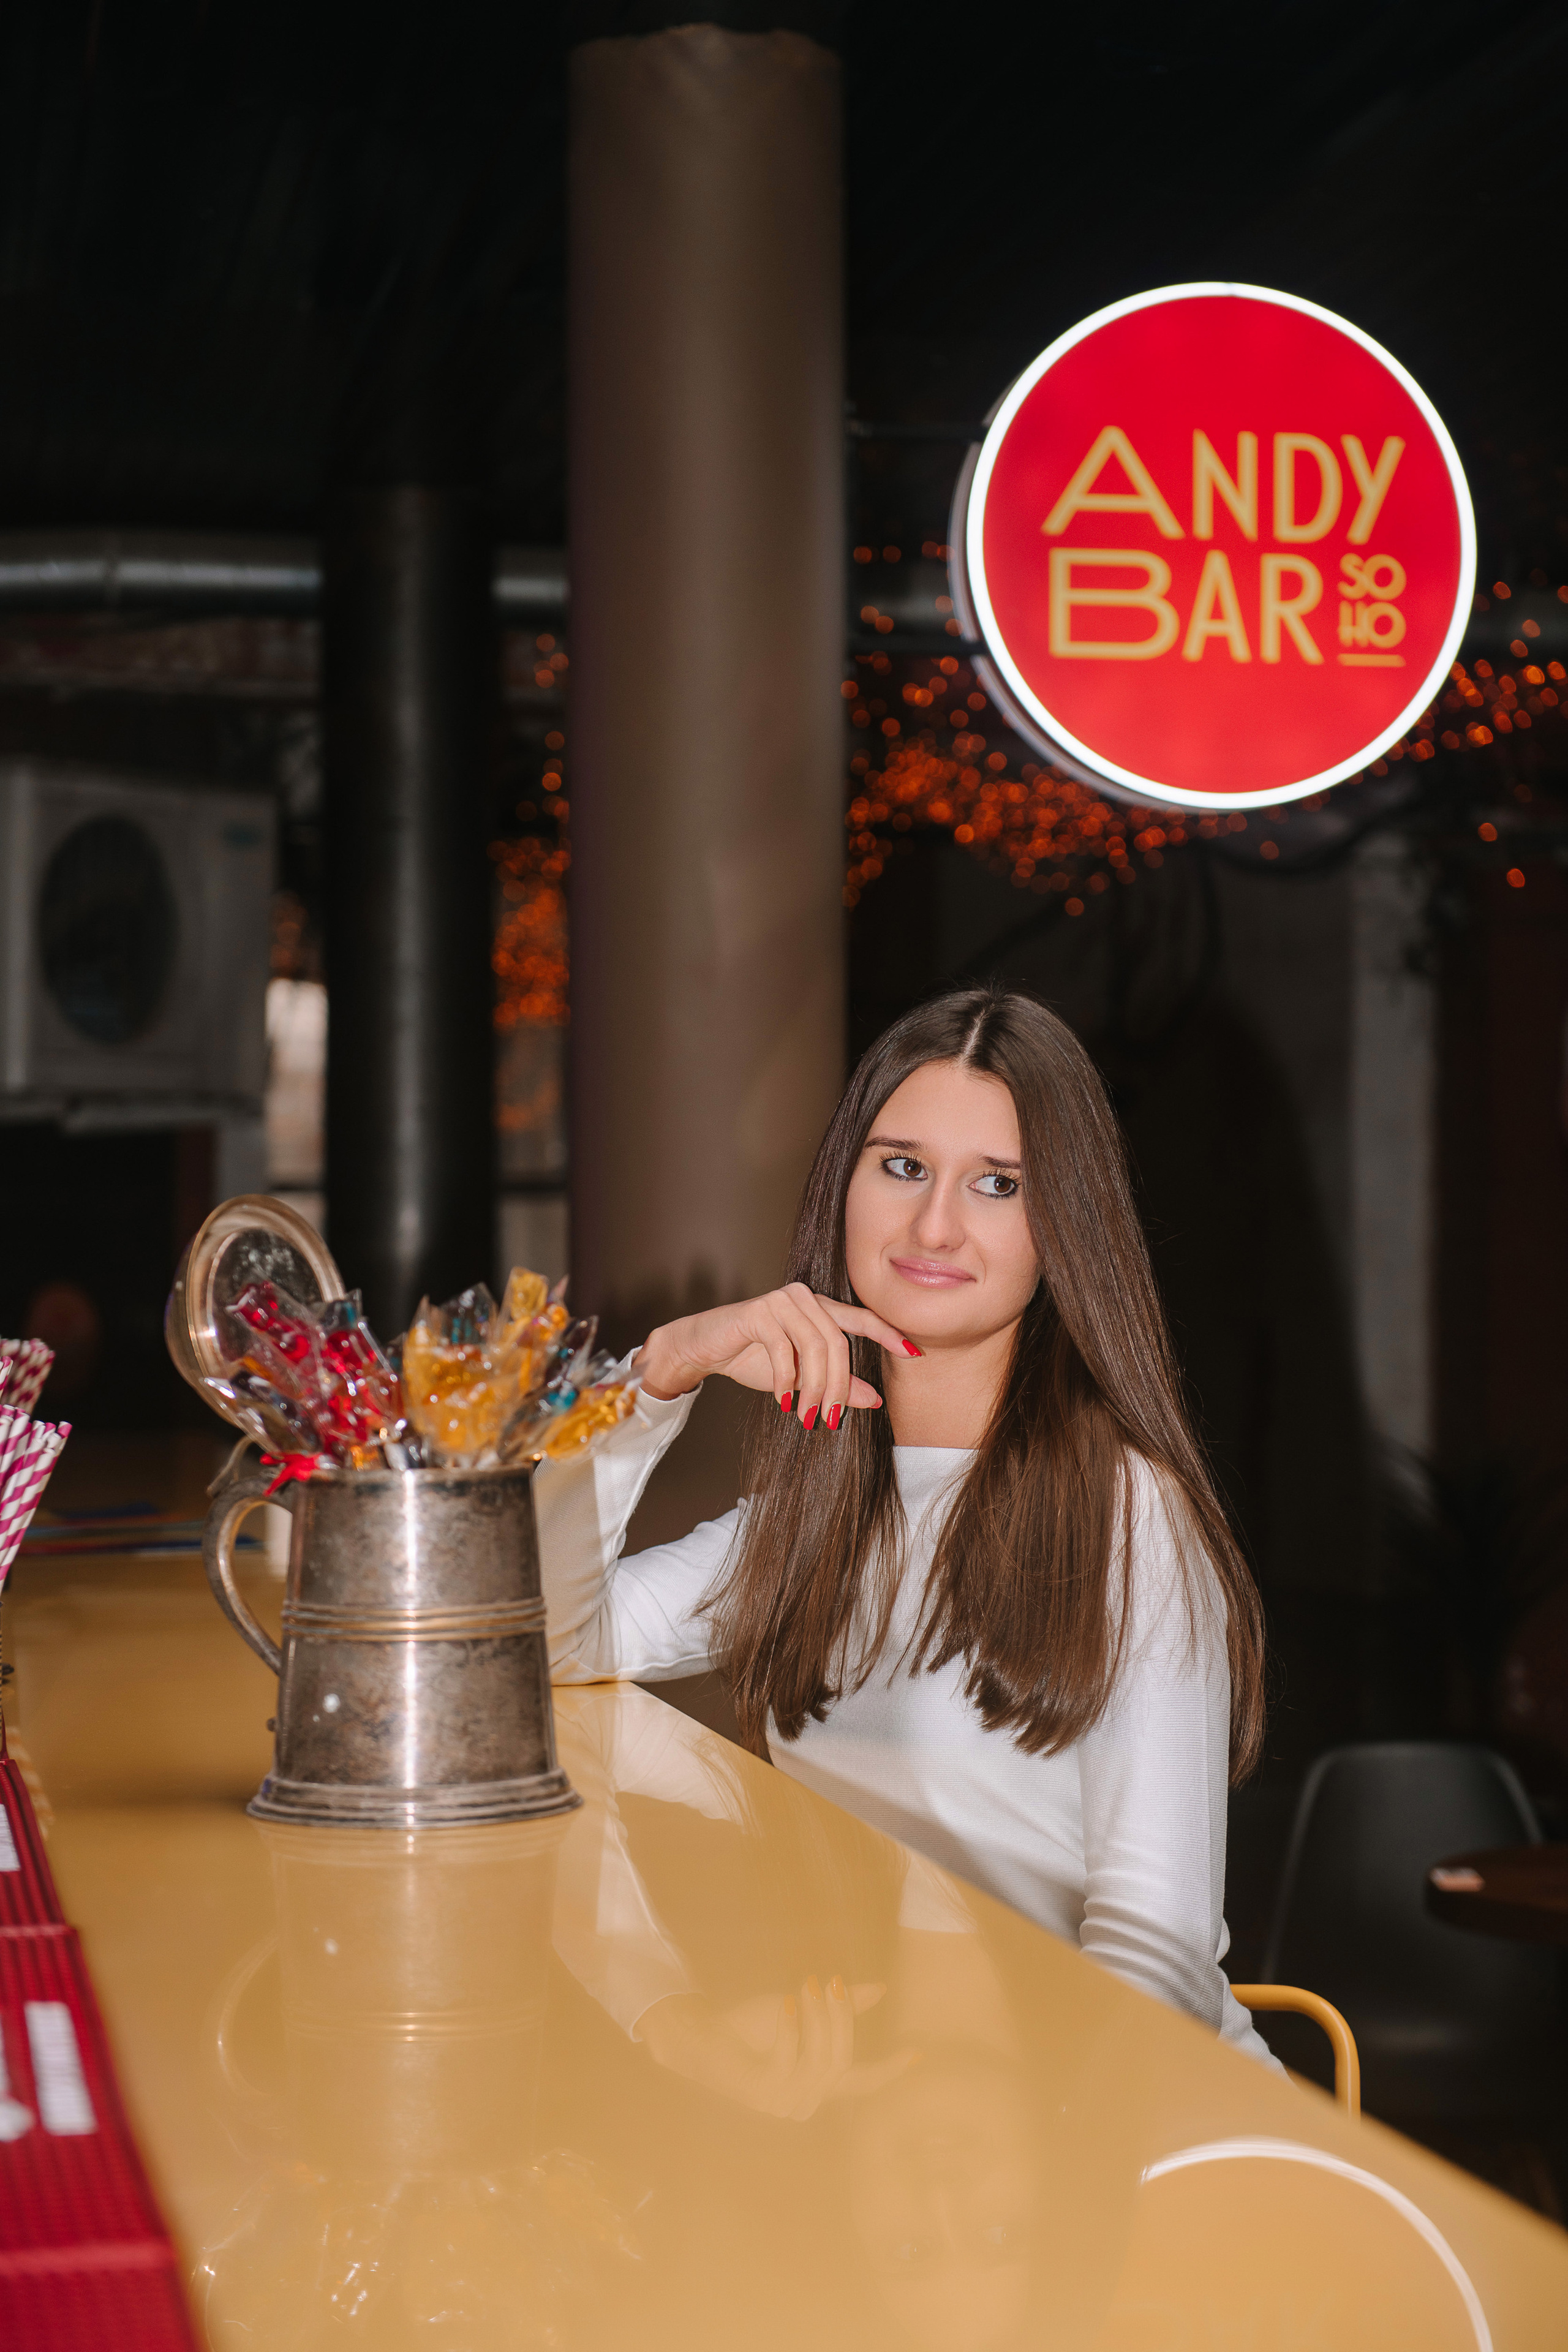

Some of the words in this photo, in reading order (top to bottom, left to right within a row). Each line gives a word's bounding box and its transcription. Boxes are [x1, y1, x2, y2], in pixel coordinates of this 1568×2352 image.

[1041, 425, 1405, 545] ANDY
[1049, 547, 1324, 665] BAR
[1338, 552, 1406, 600] SO
[1338, 600, 1406, 648] HO
